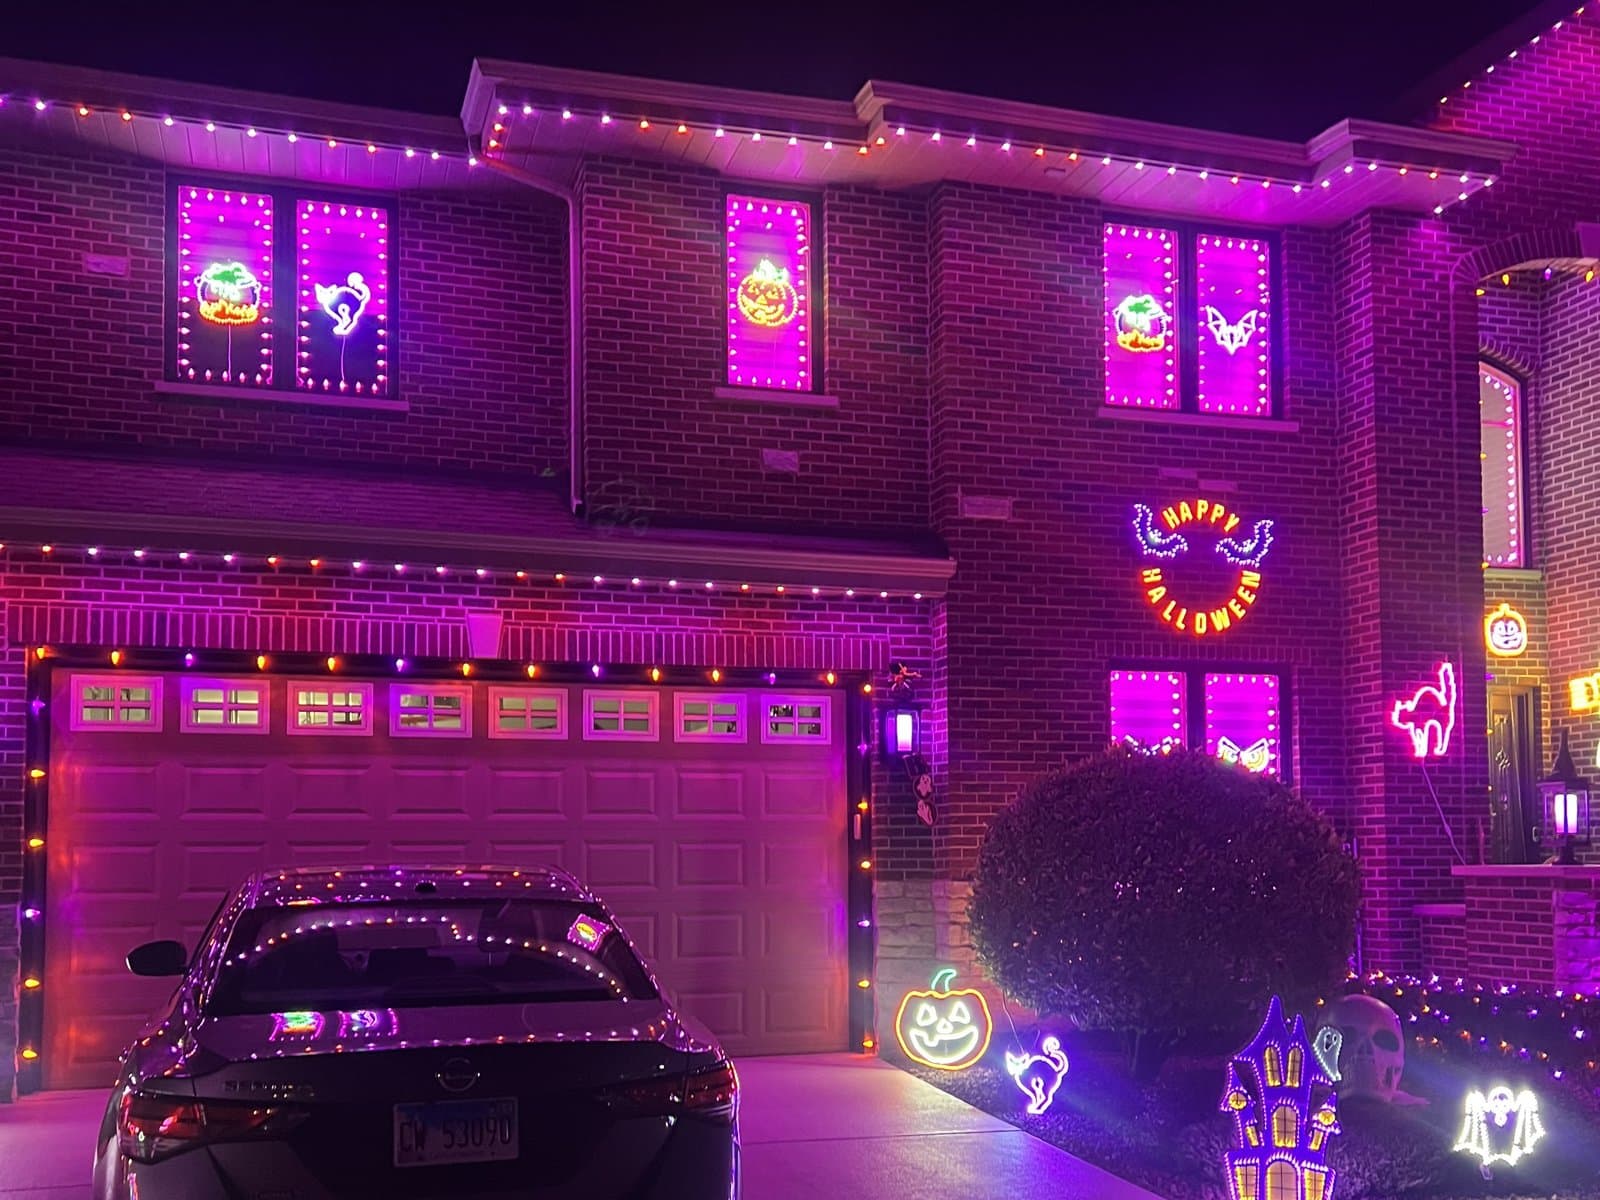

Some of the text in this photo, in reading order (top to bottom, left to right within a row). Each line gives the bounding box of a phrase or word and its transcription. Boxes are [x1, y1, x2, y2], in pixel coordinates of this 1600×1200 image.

[1162, 499, 1240, 533] HAPPY
[1142, 567, 1262, 635] HALLOWEEN
[442, 1115, 512, 1149] 53090
